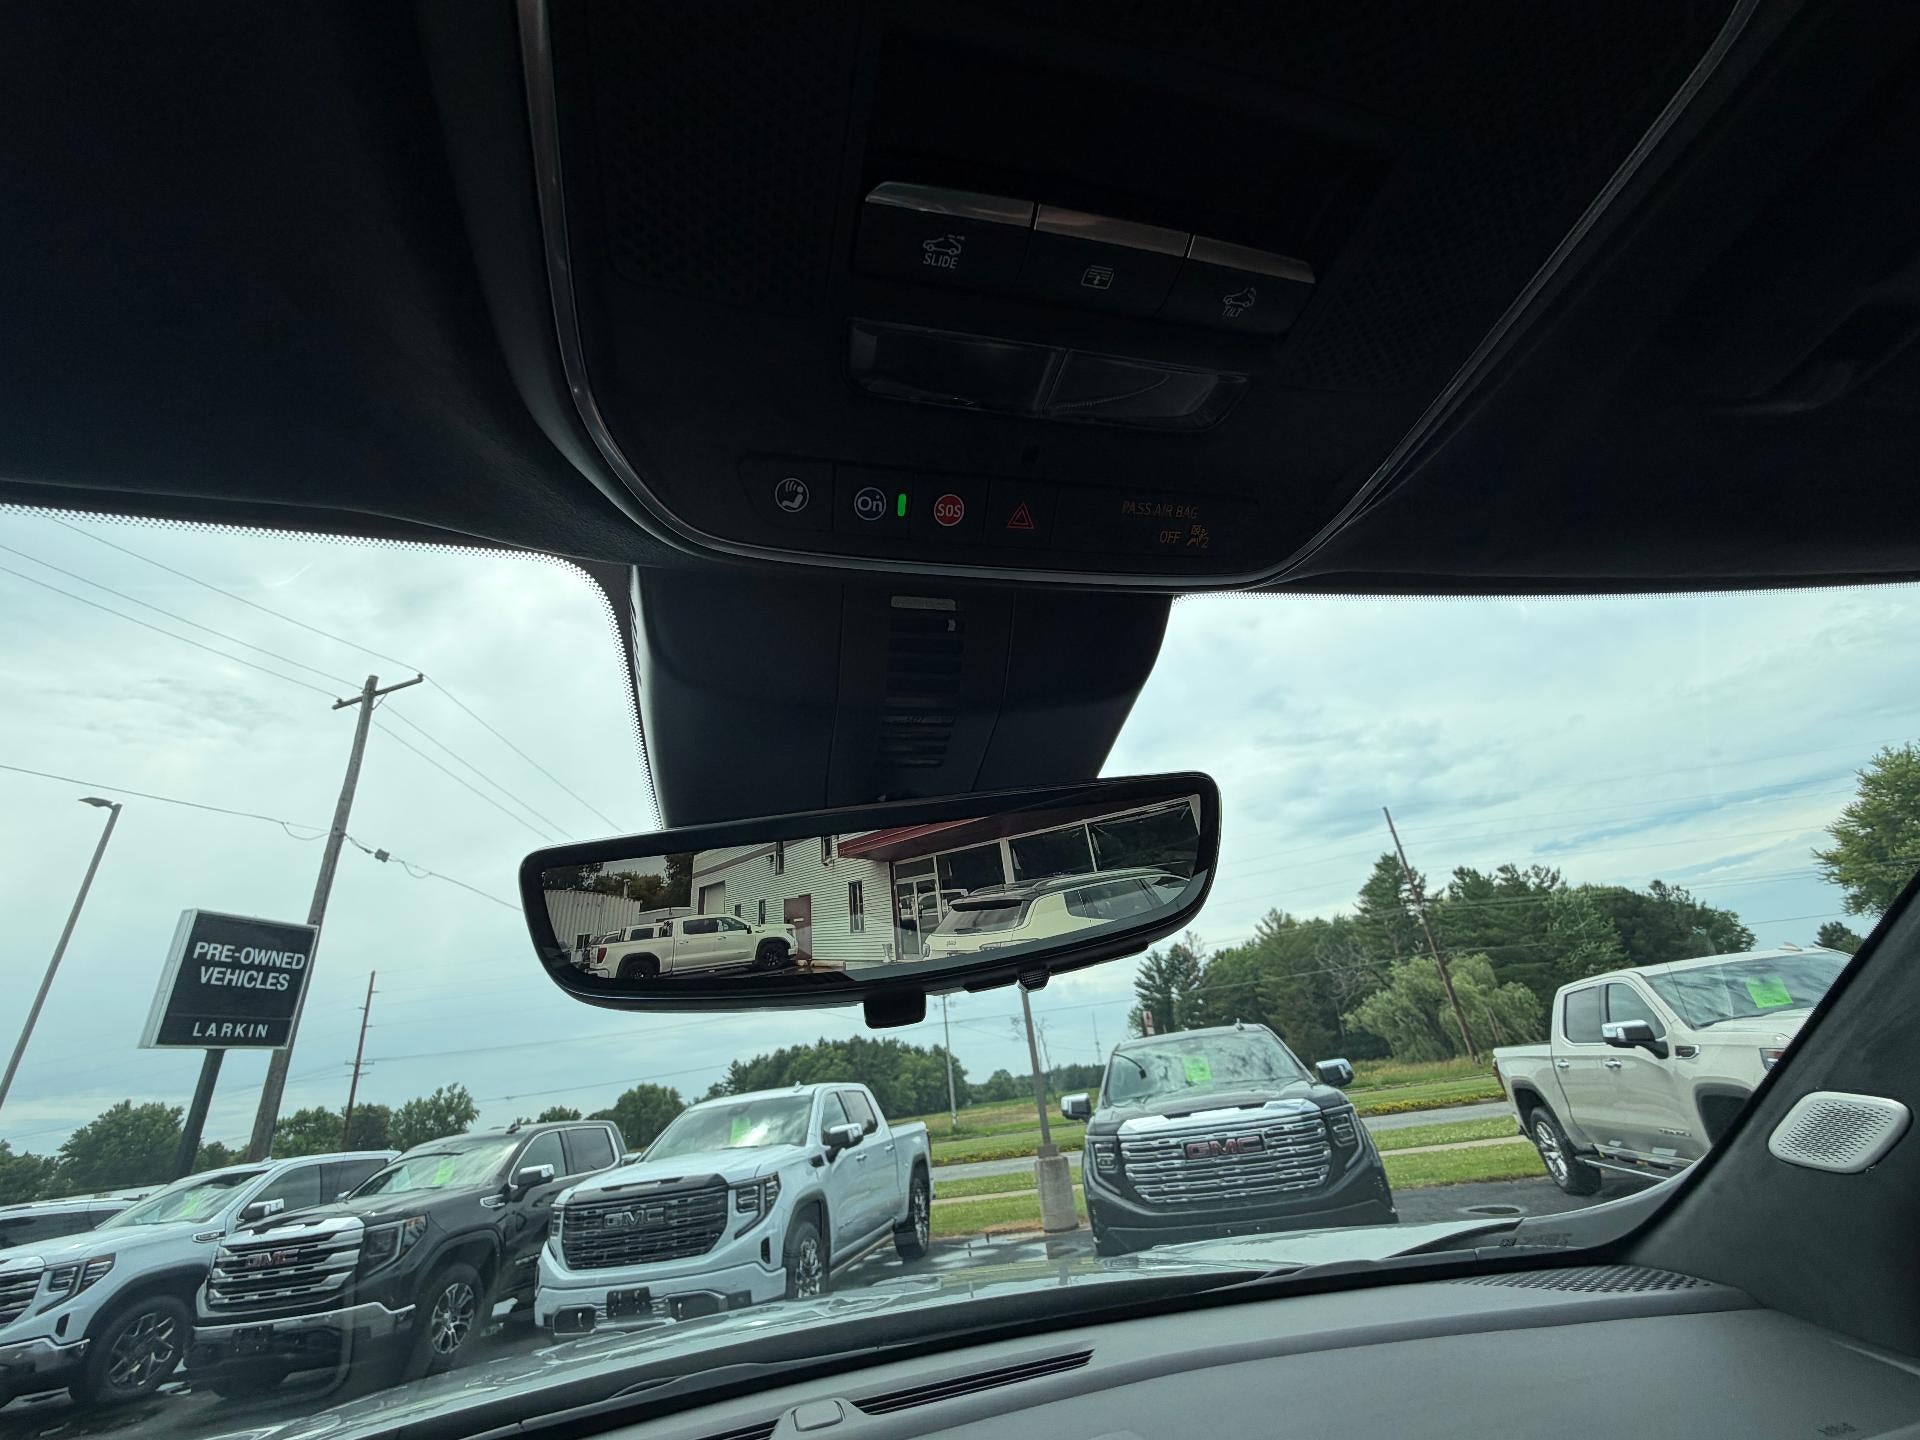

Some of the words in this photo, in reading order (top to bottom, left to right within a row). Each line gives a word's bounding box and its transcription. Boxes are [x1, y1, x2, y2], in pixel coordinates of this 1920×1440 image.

[923, 252, 959, 269] SLIDE
[1222, 304, 1243, 318] TILT
[857, 494, 883, 513] On
[936, 503, 962, 518] SOS
[1122, 500, 1152, 516] PASS
[1153, 503, 1173, 517] AIR
[1175, 505, 1200, 520] BAG
[1160, 530, 1182, 544] OFF
[192, 941, 306, 970] PRE-OWNED
[199, 965, 290, 991] VEHICLES
[192, 1022, 269, 1038] LARKIN
[1186, 1135, 1263, 1160] GMC
[604, 1207, 665, 1229] GMC
[246, 1248, 300, 1269] GMC
